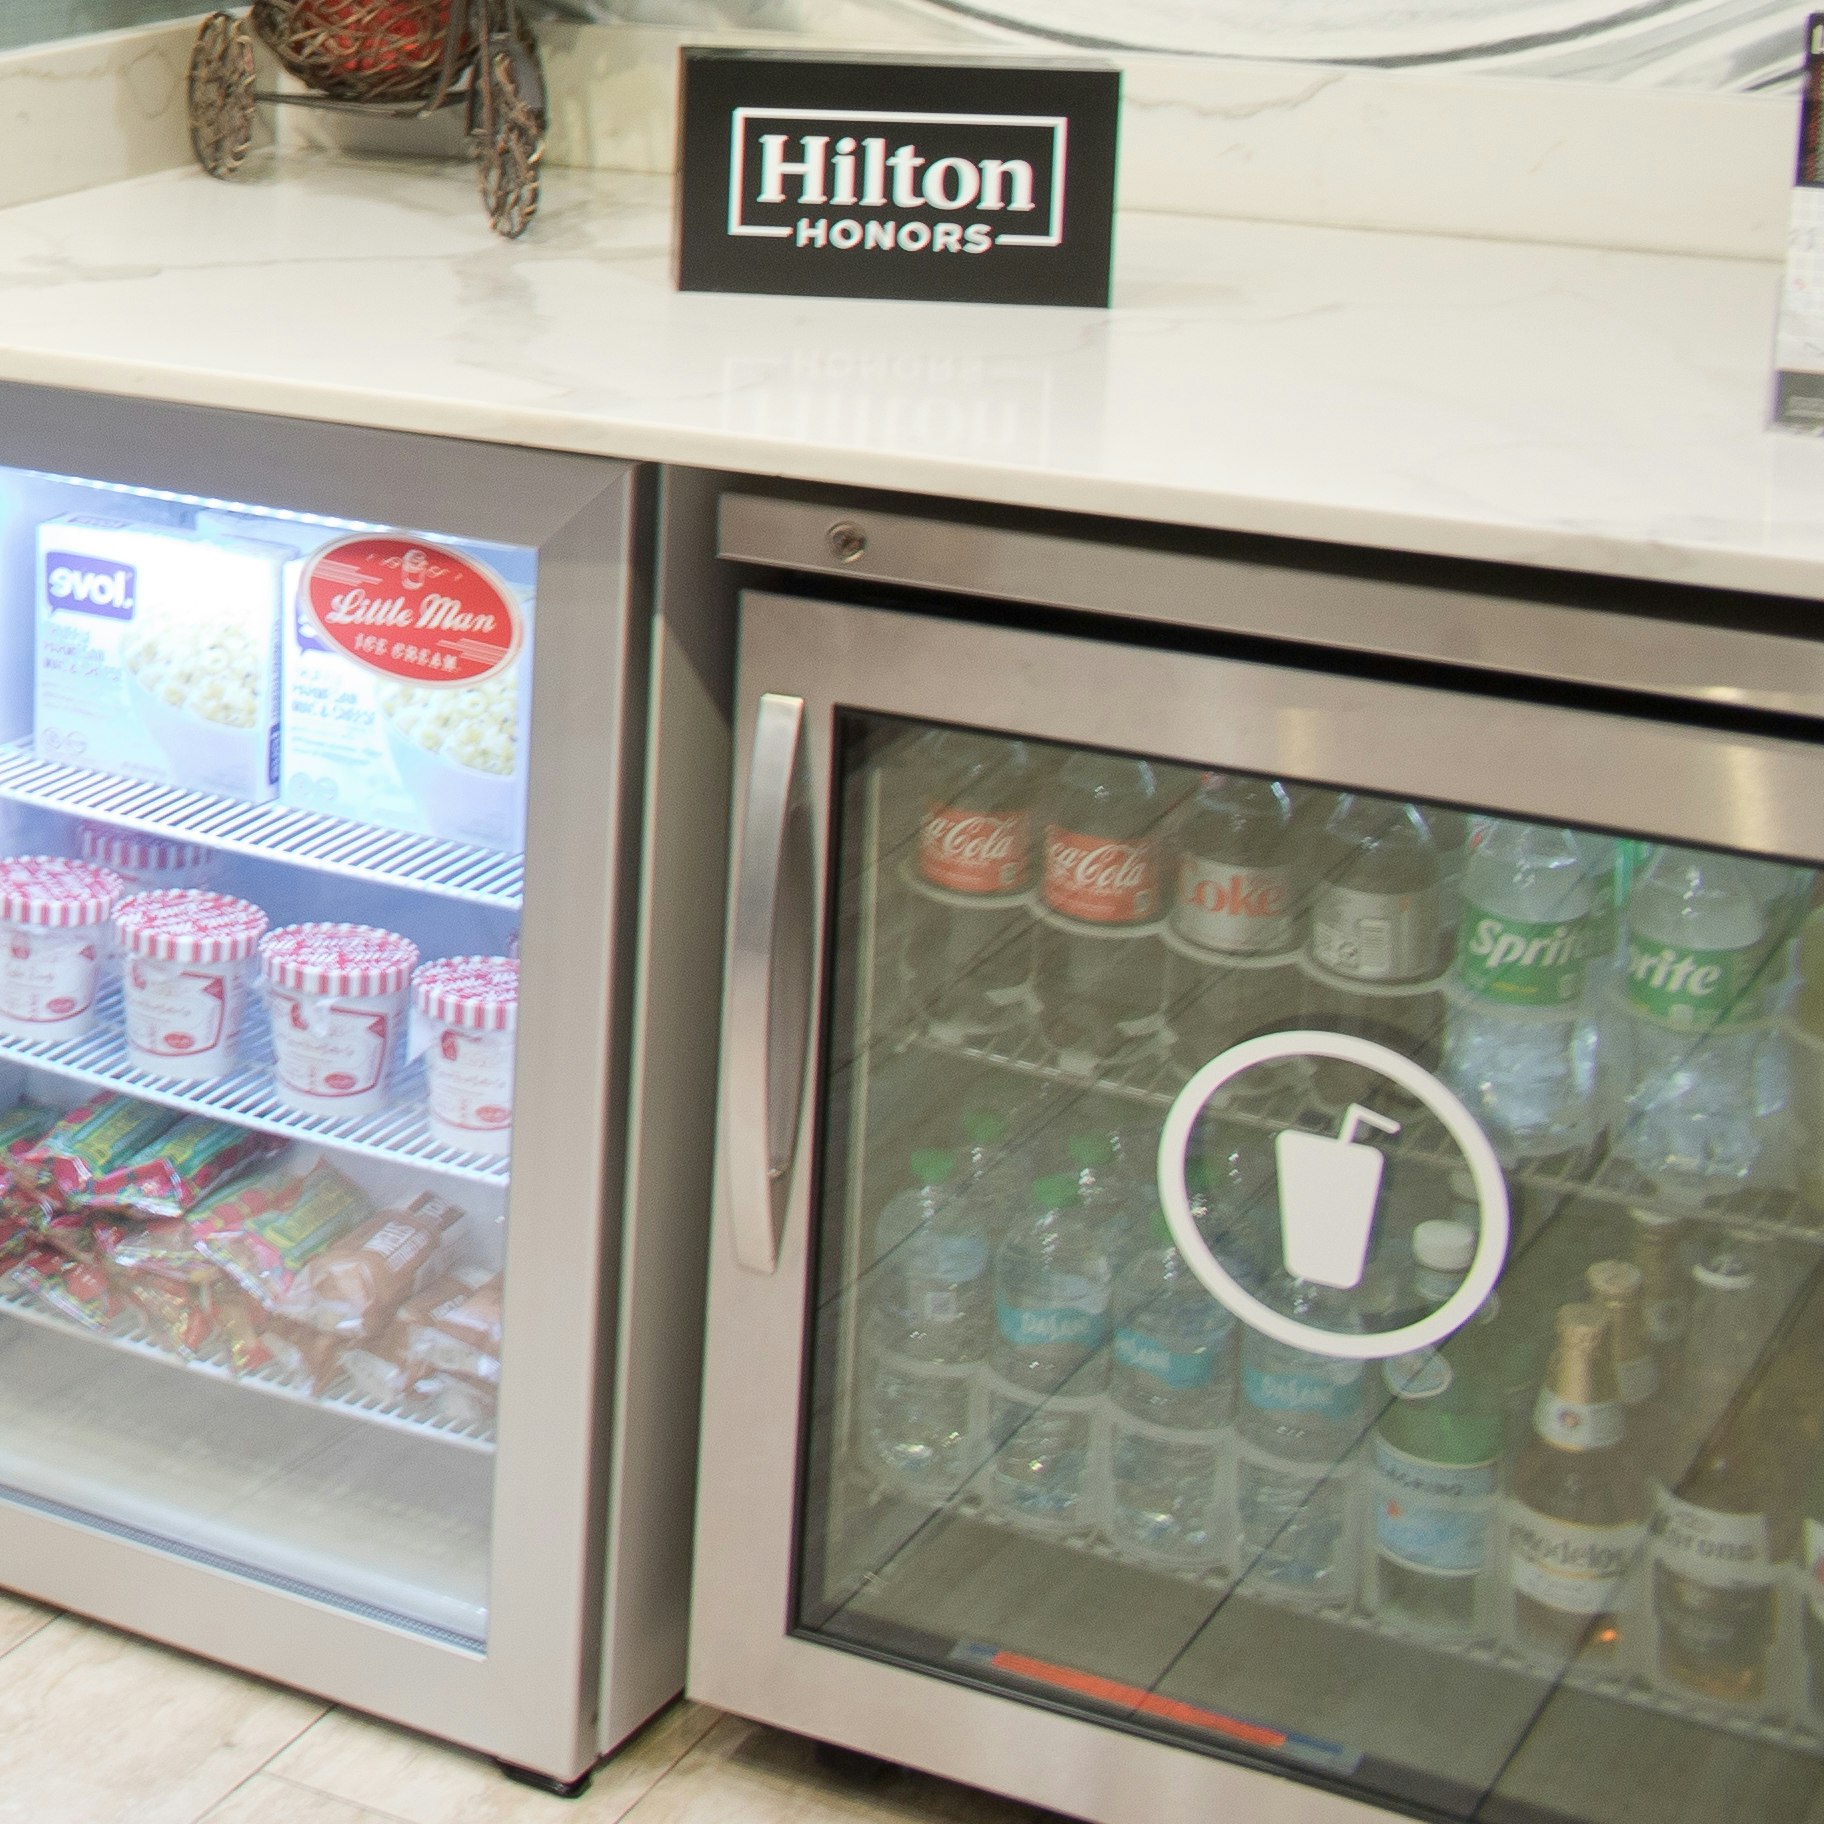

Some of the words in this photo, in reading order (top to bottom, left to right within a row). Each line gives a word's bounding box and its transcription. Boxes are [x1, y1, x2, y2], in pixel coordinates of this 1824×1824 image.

[757, 134, 1038, 214] Hilton
[796, 217, 995, 256] HONORS
[324, 588, 414, 628] Little
[414, 592, 498, 634] Man
[353, 632, 389, 657] ICE
[390, 641, 459, 674] CREAM
